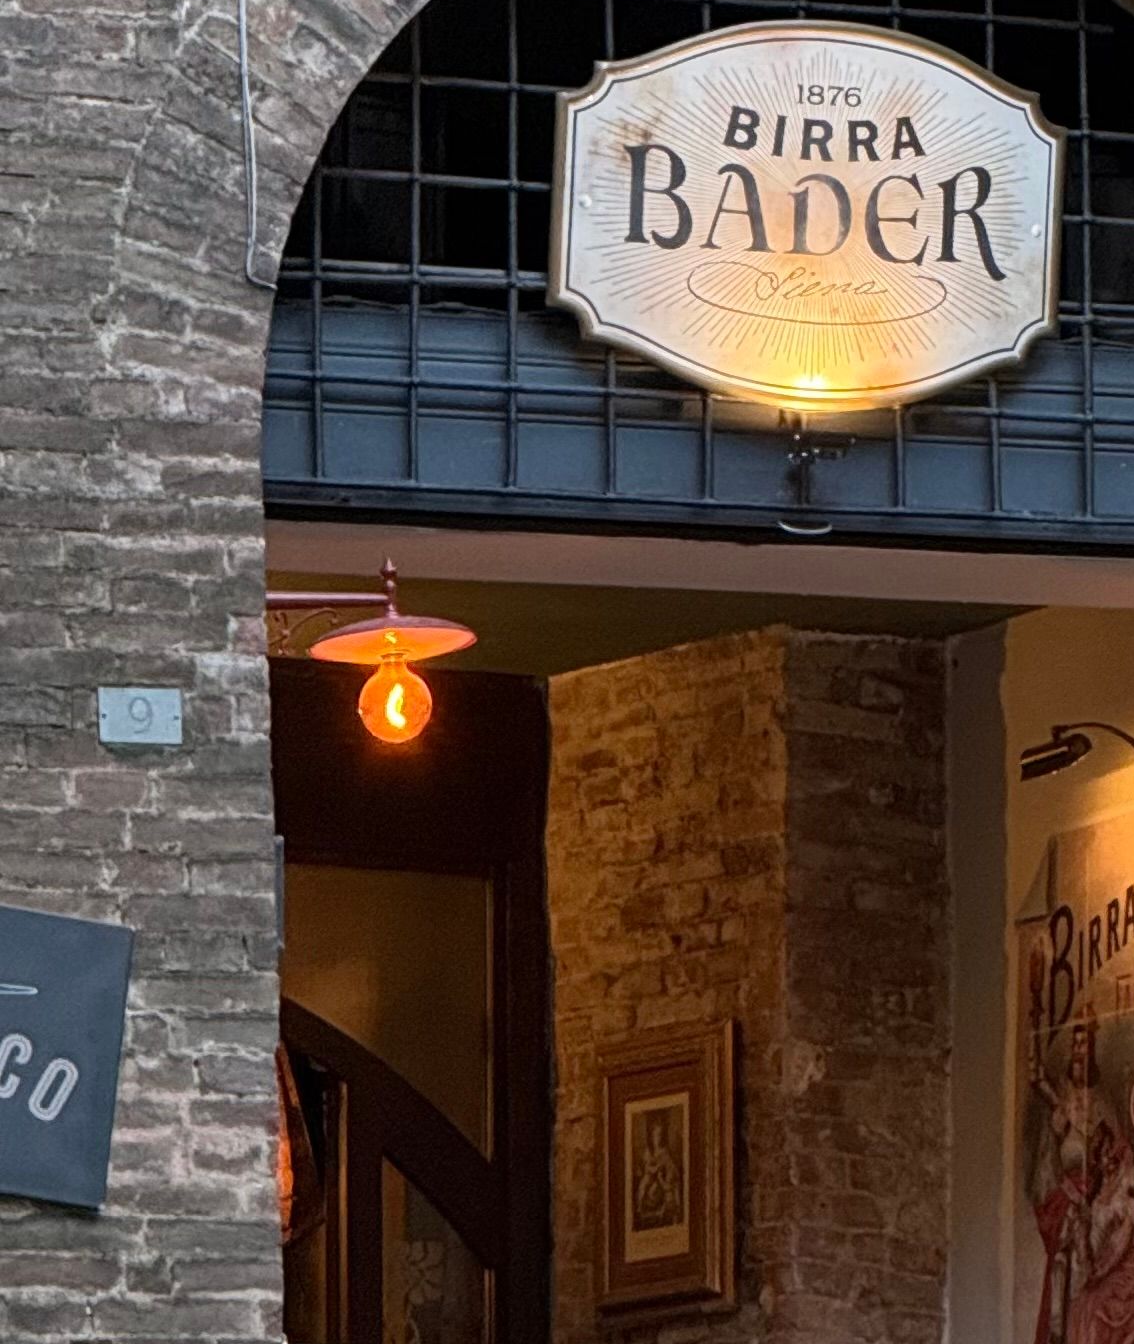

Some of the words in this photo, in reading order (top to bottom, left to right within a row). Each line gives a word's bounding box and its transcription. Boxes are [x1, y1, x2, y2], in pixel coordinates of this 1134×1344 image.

[796, 83, 862, 108] 1876
[723, 105, 926, 162] BIRRA
[624, 144, 1007, 281] BADER
[755, 266, 889, 301] Siena
[128, 697, 153, 734] 9
